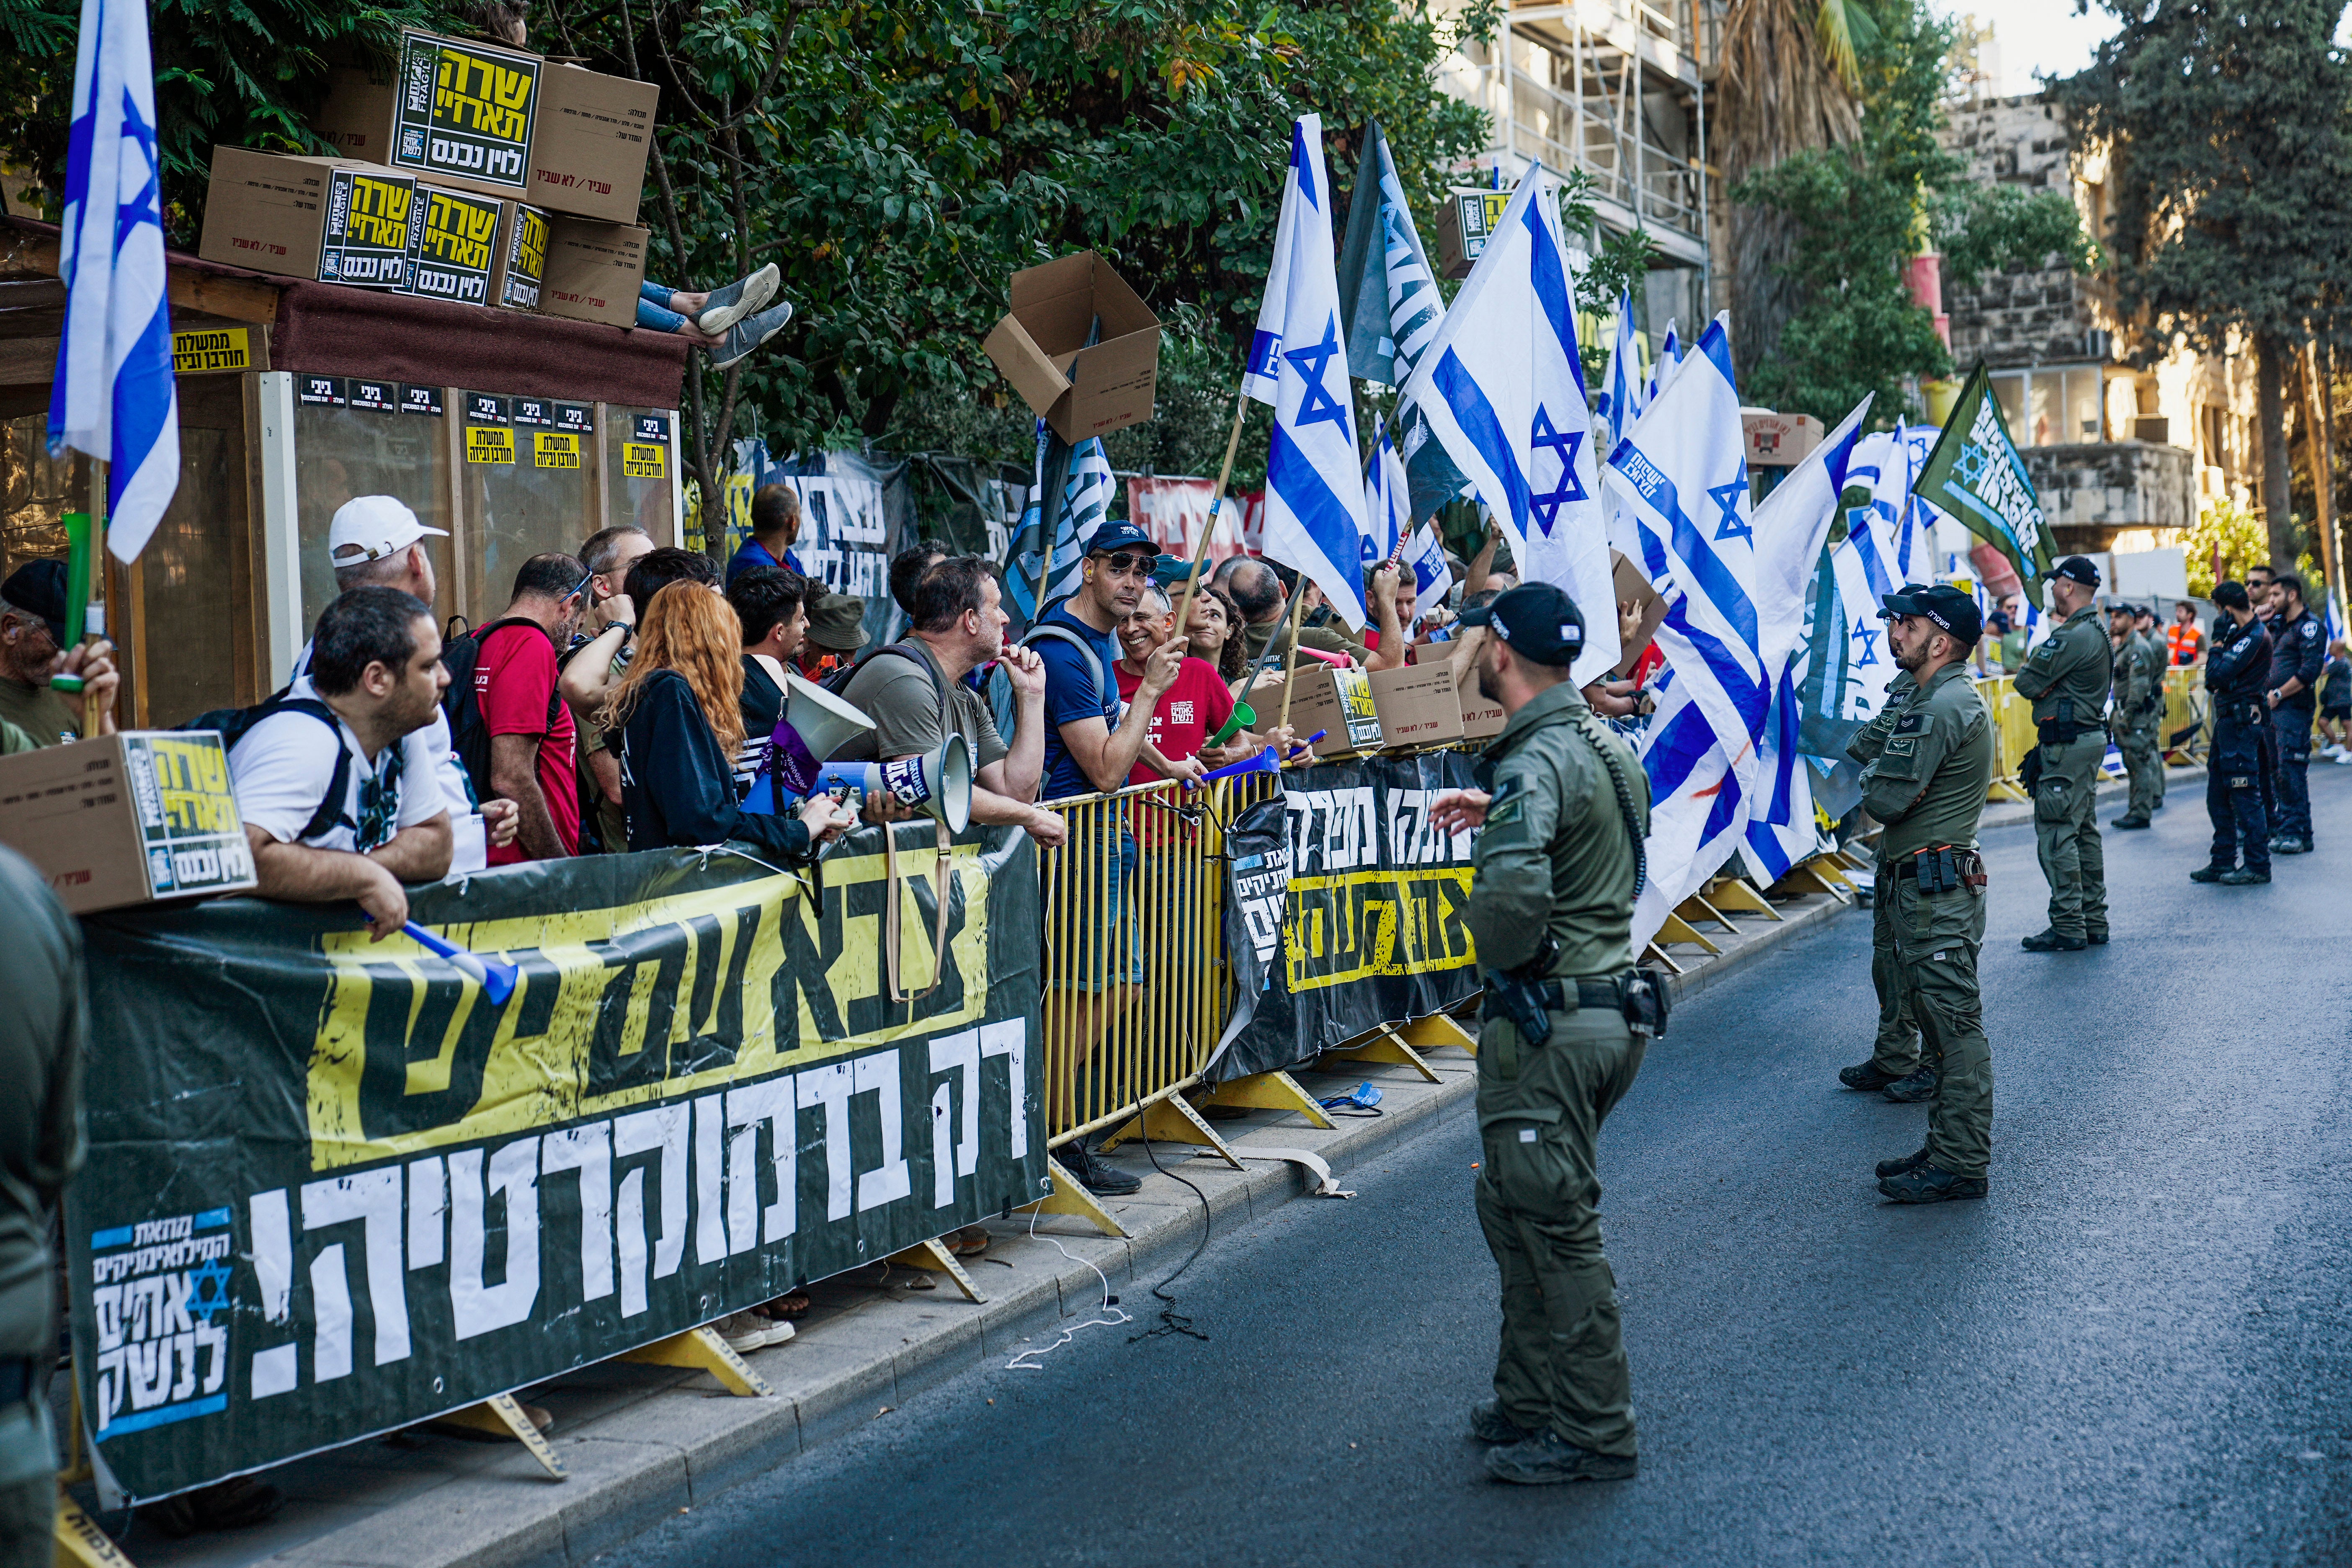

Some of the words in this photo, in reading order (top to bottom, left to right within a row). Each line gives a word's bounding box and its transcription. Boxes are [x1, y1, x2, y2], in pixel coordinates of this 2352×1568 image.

[438, 49, 532, 110] שרה
[433, 88, 526, 142] תארזי!
[402, 144, 422, 157] לנשק
[403, 136, 418, 147] אחים
[431, 138, 484, 169] נכנס
[486, 148, 522, 175] לוין
[537, 169, 560, 184] שביר
[561, 174, 575, 187] לא
[588, 179, 611, 195] שביר
[351, 176, 412, 222] שרה
[336, 182, 348, 235] FRAGILE
[1472, 199, 1482, 231] FRAGILE
[410, 197, 425, 248] FRAGILE
[427, 193, 496, 243] שרה
[347, 211, 407, 249] תארזי!
[523, 210, 549, 255] שרה
[232, 237, 249, 249] שביר
[251, 240, 260, 250] לא
[269, 244, 286, 255] שביר
[422, 226, 490, 270] תארזי!
[343, 256, 379, 278] נכנס
[378, 256, 403, 281] לוין
[518, 242, 544, 280] תארזי!
[418, 269, 457, 293] נכנס
[457, 275, 484, 298] לוין
[551, 290, 568, 301] שביר
[569, 294, 579, 302] לא
[588, 297, 605, 307] שביר
[176, 333, 230, 352] ממשלת
[174, 352, 201, 370] וביז
[204, 350, 244, 369] חורבן
[311, 380, 332, 395] ביבי
[361, 385, 381, 401] ביבי
[411, 389, 430, 404] ביבי
[478, 398, 496, 414] ביבי
[523, 402, 541, 417] ביבי
[566, 409, 582, 423] ביבי
[643, 419, 659, 433] ביבי
[476, 428, 505, 446] ממשלת
[544, 435, 570, 452] ממשלת
[469, 446, 489, 462] וביזה
[492, 446, 512, 462] חורבן
[537, 451, 556, 467] וביזה
[558, 451, 577, 467] חורבן
[632, 445, 656, 461] ממשלת
[626, 460, 642, 476] וביזה
[645, 462, 662, 477] חורבן
[1927, 610, 1951, 630] משטרה
[1343, 671, 1371, 698] שרה
[1172, 714, 1194, 722] לנשק
[1467, 712, 1476, 722] לא
[1485, 708, 1502, 719] שביר
[152, 738, 228, 794] שרה
[1283, 786, 1378, 879] מפרק
[173, 848, 221, 883] נכנס
[771, 867, 966, 1054] צבא
[929, 1016, 1027, 1209] רק
[133, 1215, 193, 1248] מחאת
[250, 1048, 912, 1400] בדמוקרטיה!
[93, 1232, 230, 1284] המילואימניקים
[93, 1269, 196, 1351] אחים
[96, 1318, 228, 1432] לנשק
